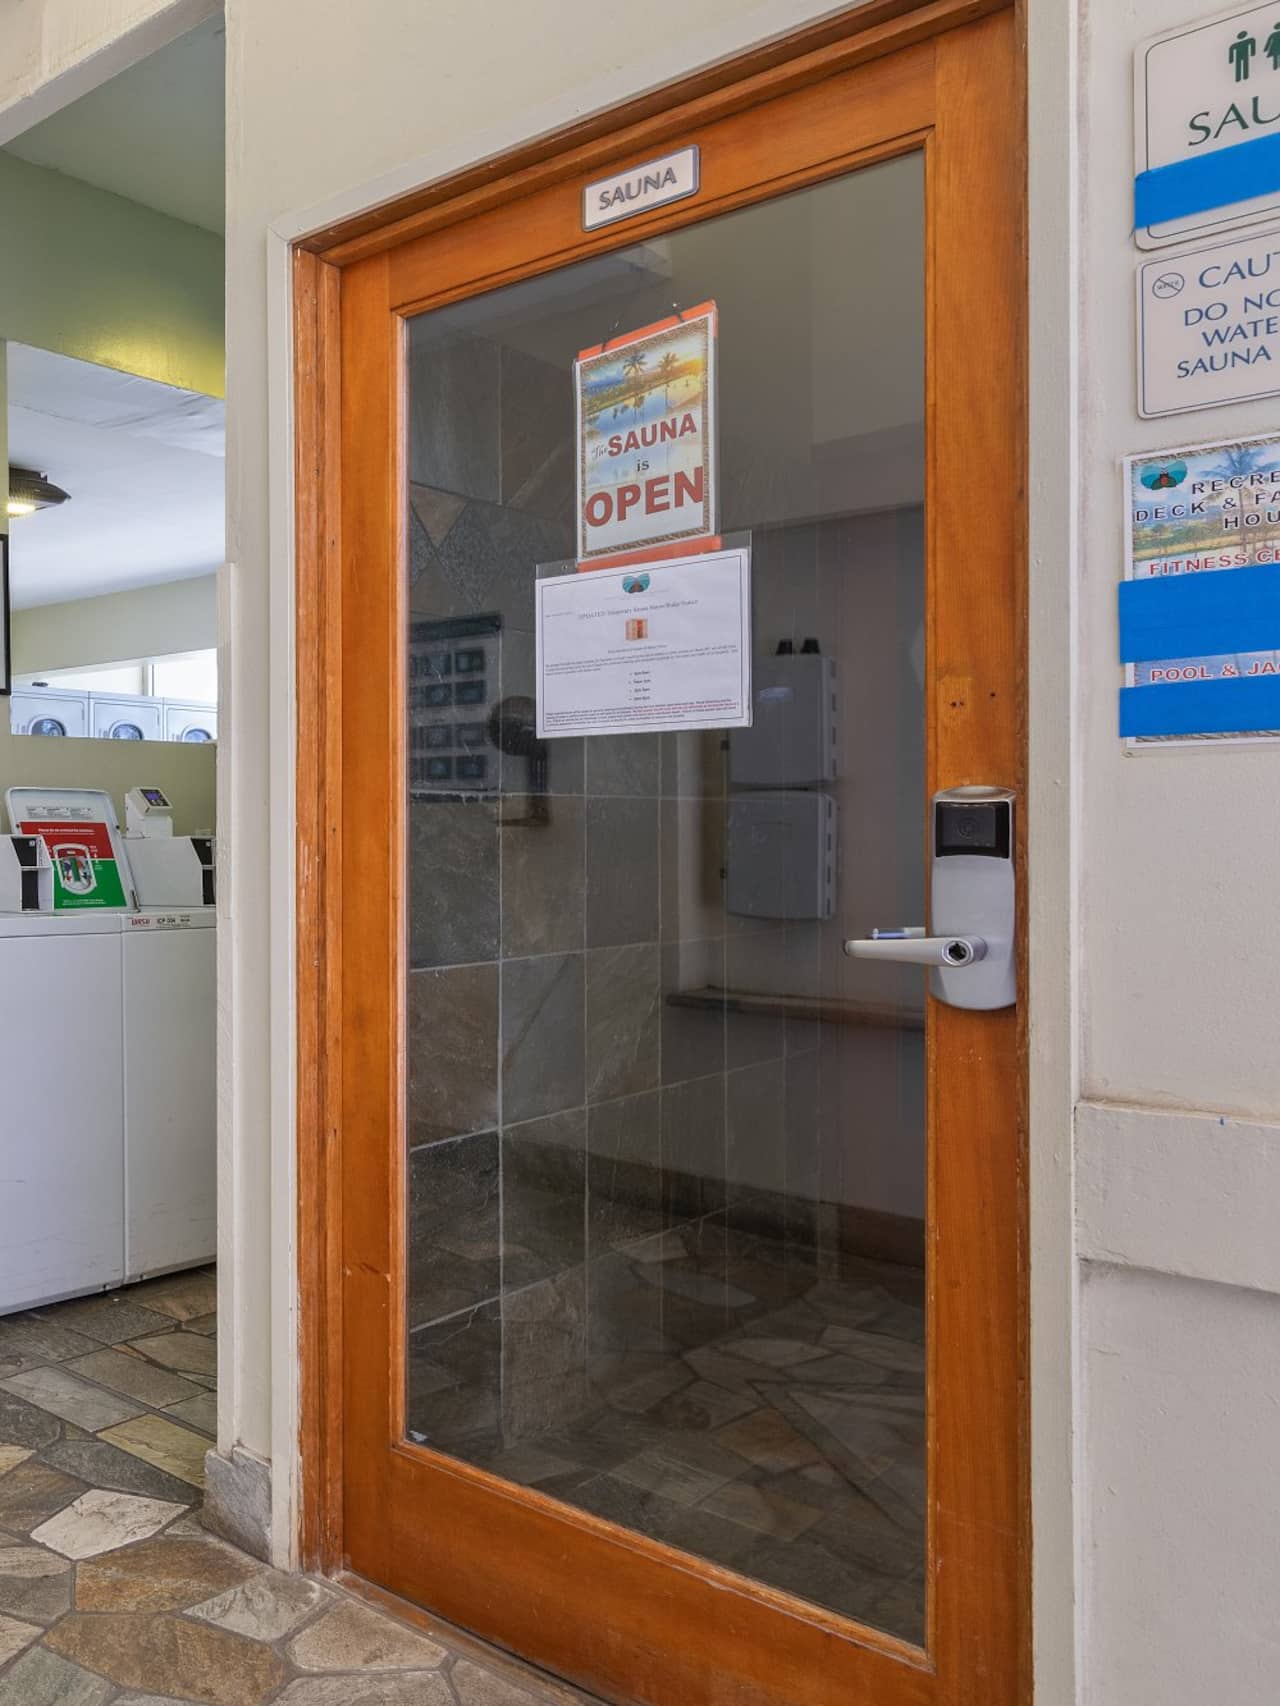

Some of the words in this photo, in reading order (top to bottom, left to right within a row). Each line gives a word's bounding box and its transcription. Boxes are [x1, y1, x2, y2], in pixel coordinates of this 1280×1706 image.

[1188, 96, 1280, 146] SAU
[599, 167, 677, 210] SAUNA
[1184, 303, 1228, 326] DO
[1177, 345, 1271, 378] SAUNA
[608, 413, 697, 457] SAUNA
[637, 459, 650, 472] is
[1192, 471, 1280, 494] RECRE
[585, 466, 704, 527] OPEN
[1136, 501, 1205, 521] DECK
[1222, 498, 1237, 509] &
[1224, 511, 1280, 529] HOU
[1150, 553, 1248, 576] FITNESS
[1151, 666, 1211, 682] POOL
[1222, 665, 1237, 677] &
[1248, 661, 1280, 675] JA
